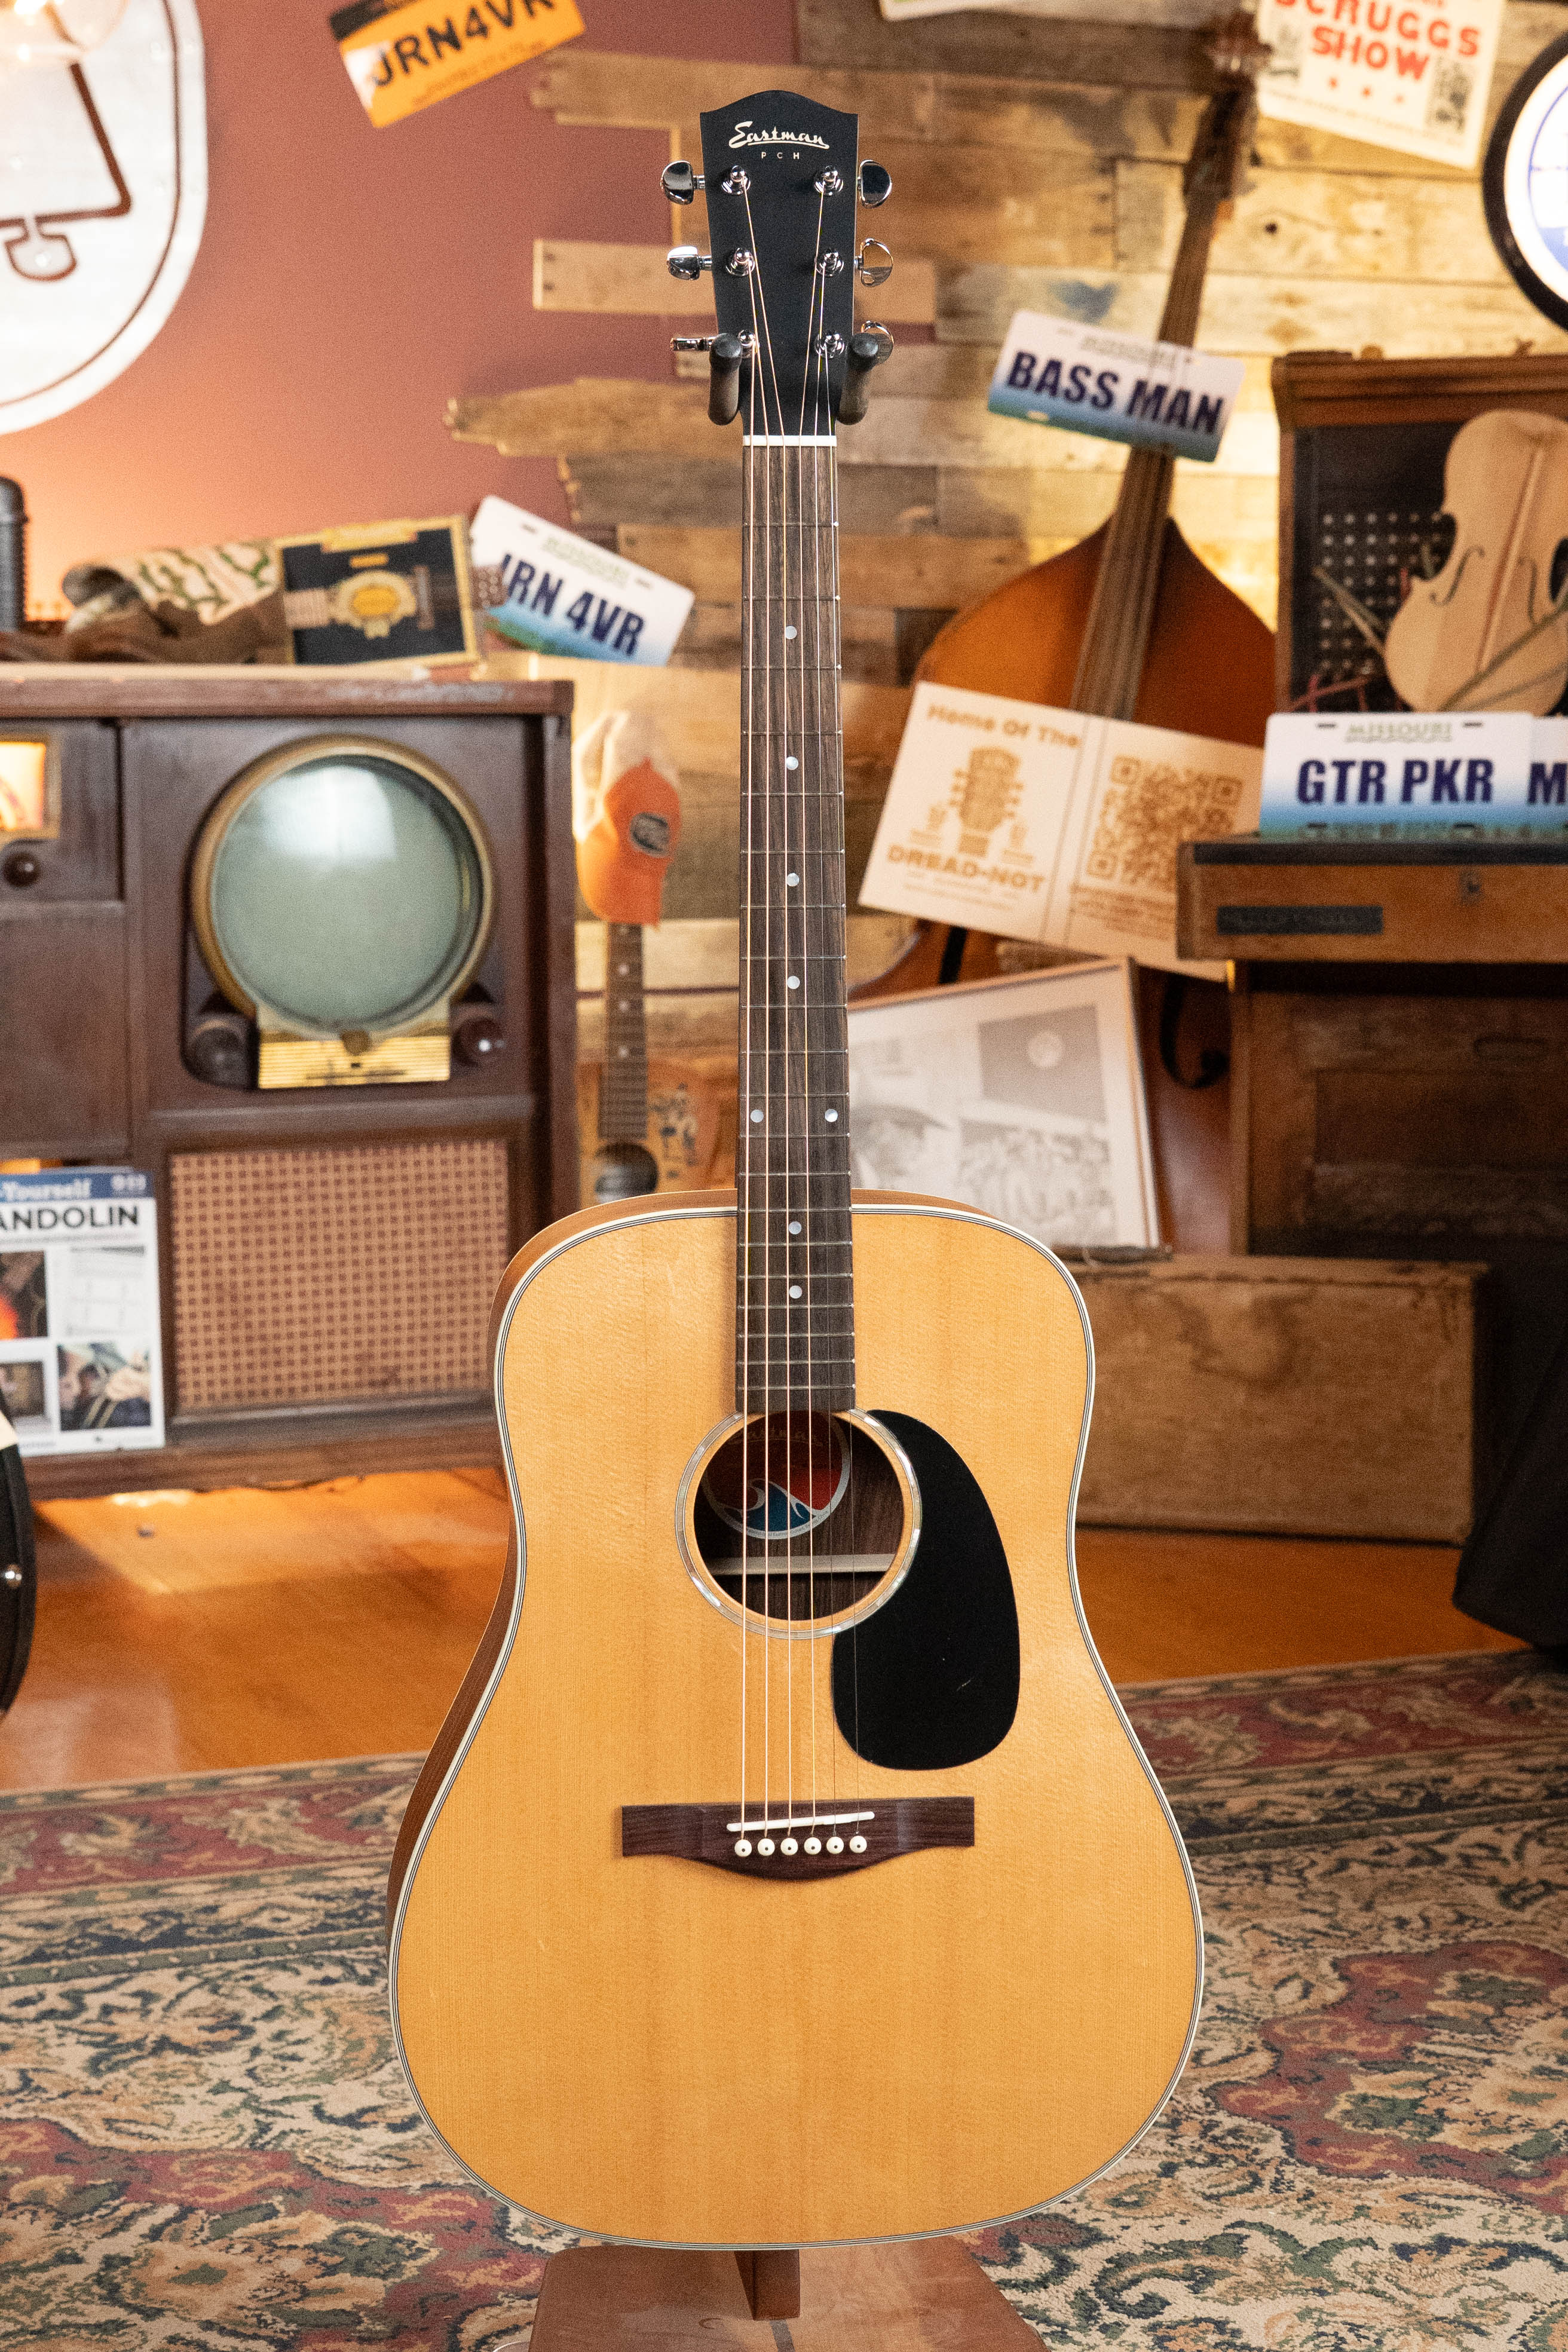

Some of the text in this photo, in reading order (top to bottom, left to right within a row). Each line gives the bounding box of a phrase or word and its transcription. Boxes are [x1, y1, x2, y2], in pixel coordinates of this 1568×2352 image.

[1312, 25, 1429, 81] SHOW
[728, 121, 830, 149] Eastman
[1008, 351, 1224, 434] BASS MAN
[566, 591, 645, 657] 4VR
[926, 703, 996, 733] Home
[1039, 724, 1083, 748] The
[1296, 759, 1494, 805] GTR PKR
[887, 844, 1046, 894] DREAD-NOT
